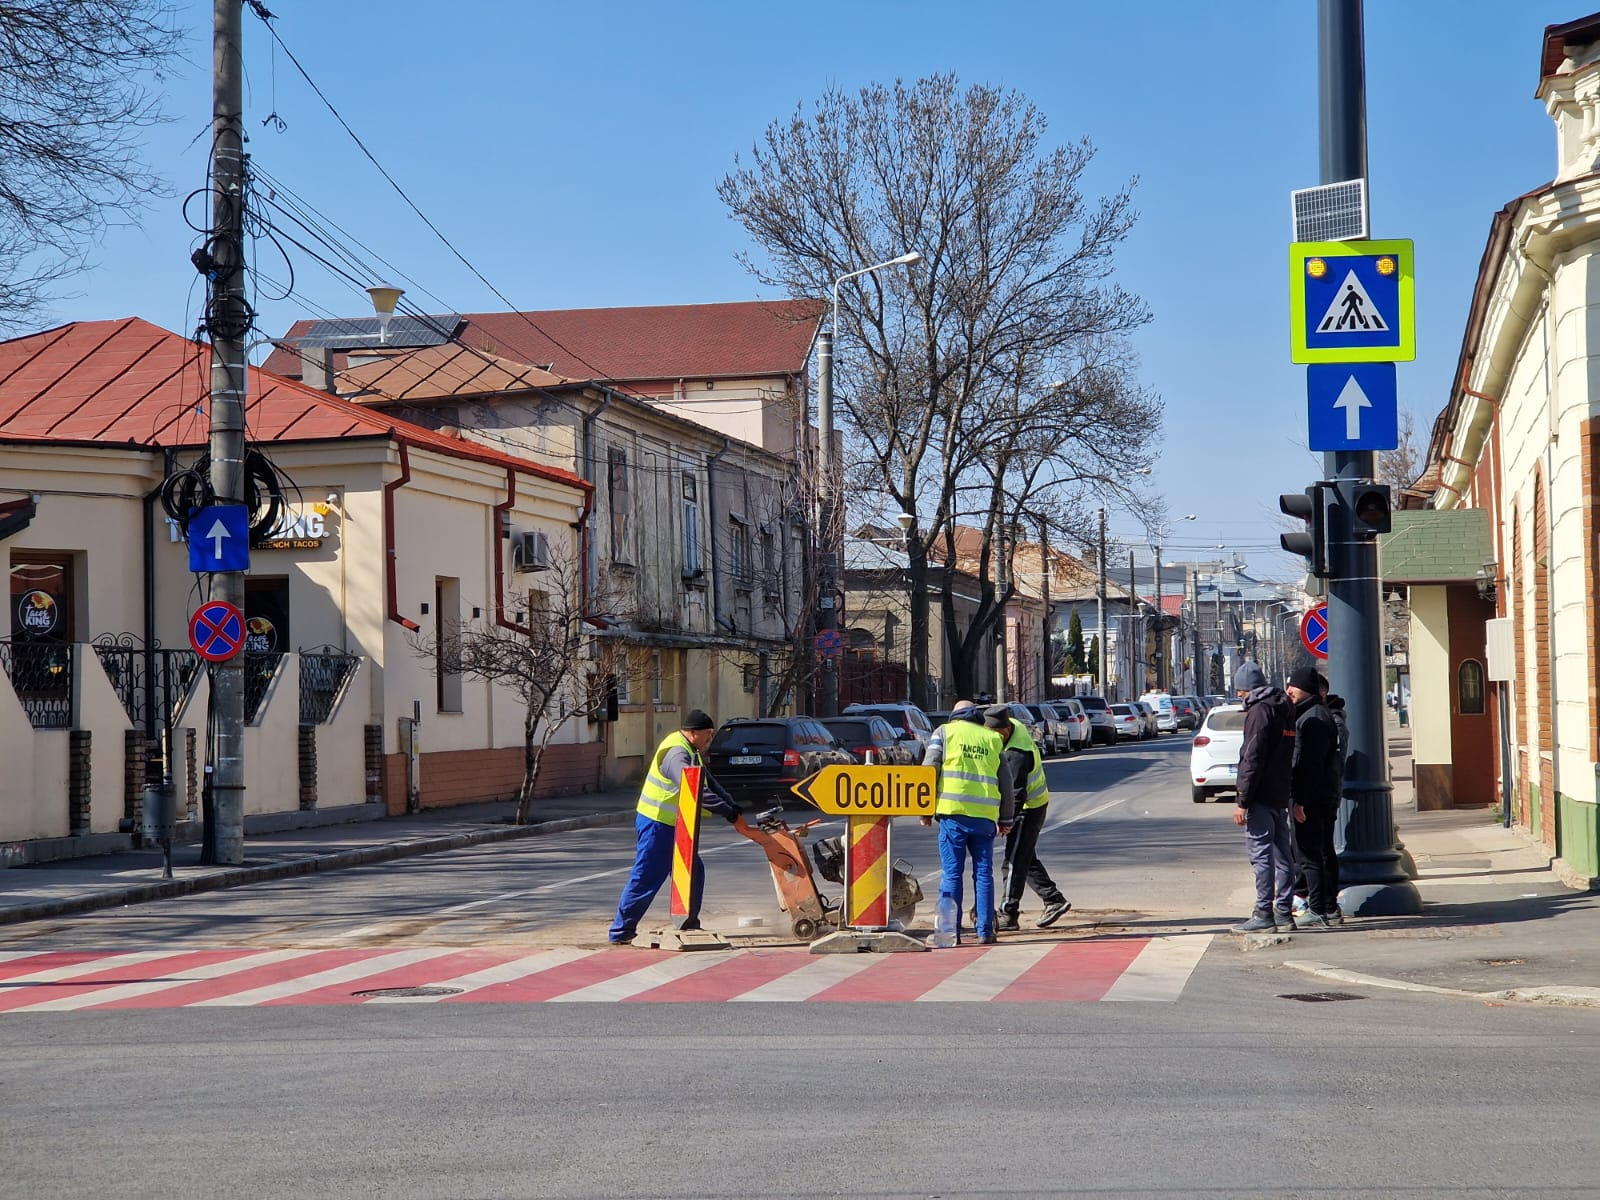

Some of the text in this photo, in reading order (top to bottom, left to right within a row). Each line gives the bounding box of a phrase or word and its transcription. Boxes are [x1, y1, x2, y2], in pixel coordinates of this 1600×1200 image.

[293, 540, 319, 548] TACOS
[26, 616, 50, 626] KING
[959, 743, 989, 756] TANCRAD
[835, 772, 931, 809] Ocolire
